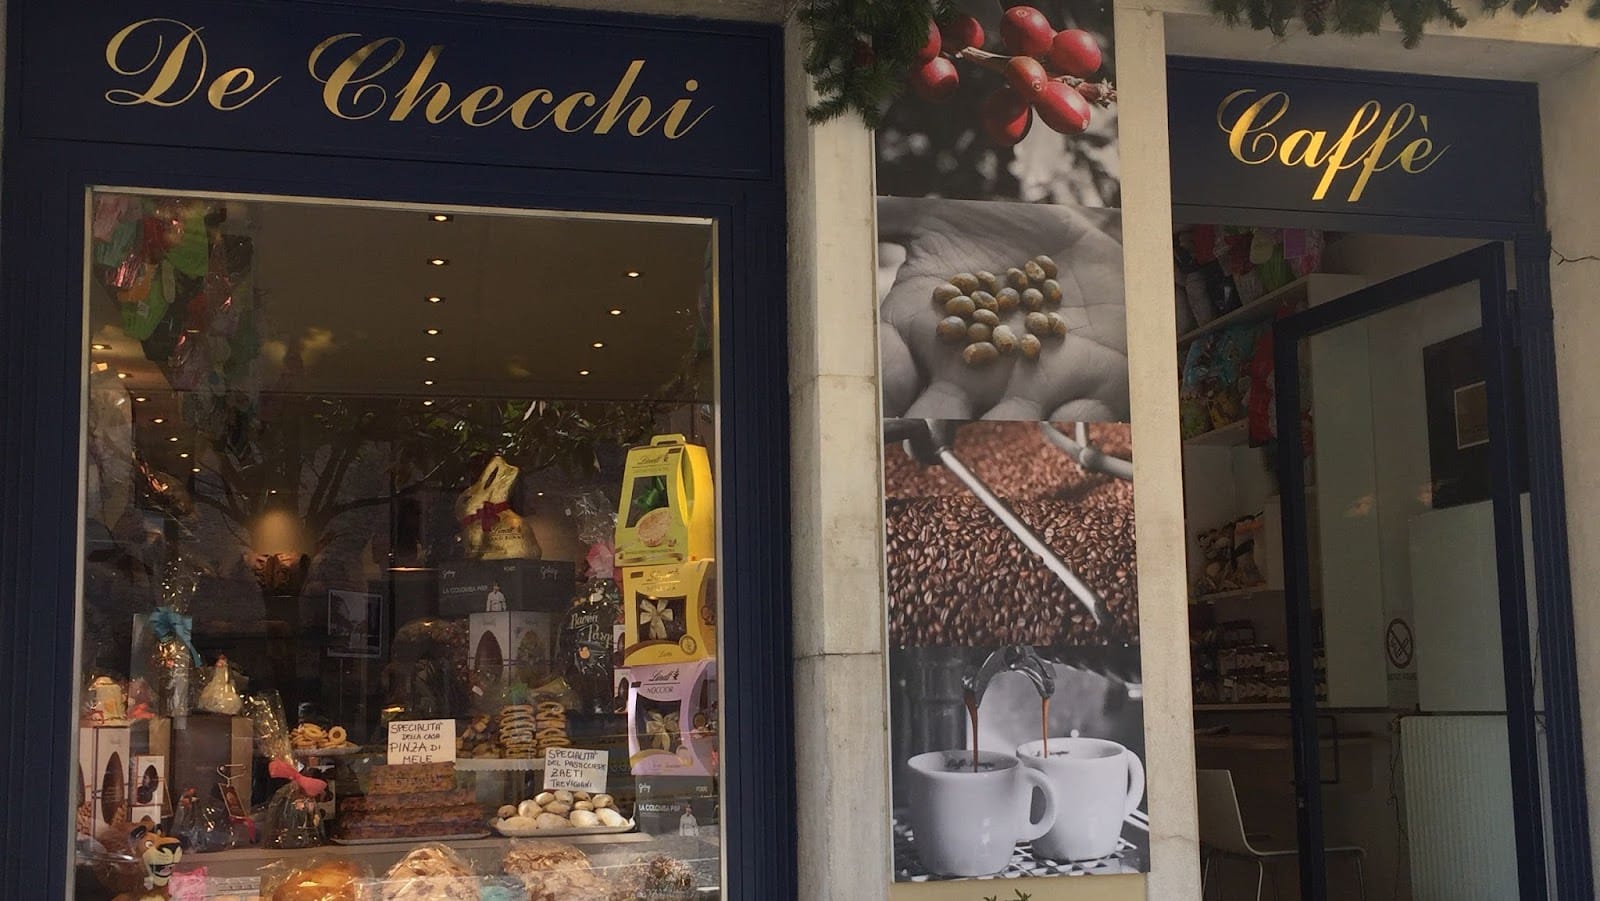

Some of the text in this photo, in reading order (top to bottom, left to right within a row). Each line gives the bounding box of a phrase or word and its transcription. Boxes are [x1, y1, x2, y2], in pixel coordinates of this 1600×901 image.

[105, 18, 715, 139] De Checchi
[1216, 89, 1450, 202] Caffè
[389, 742, 427, 752] PINZA
[402, 754, 433, 765] MELE
